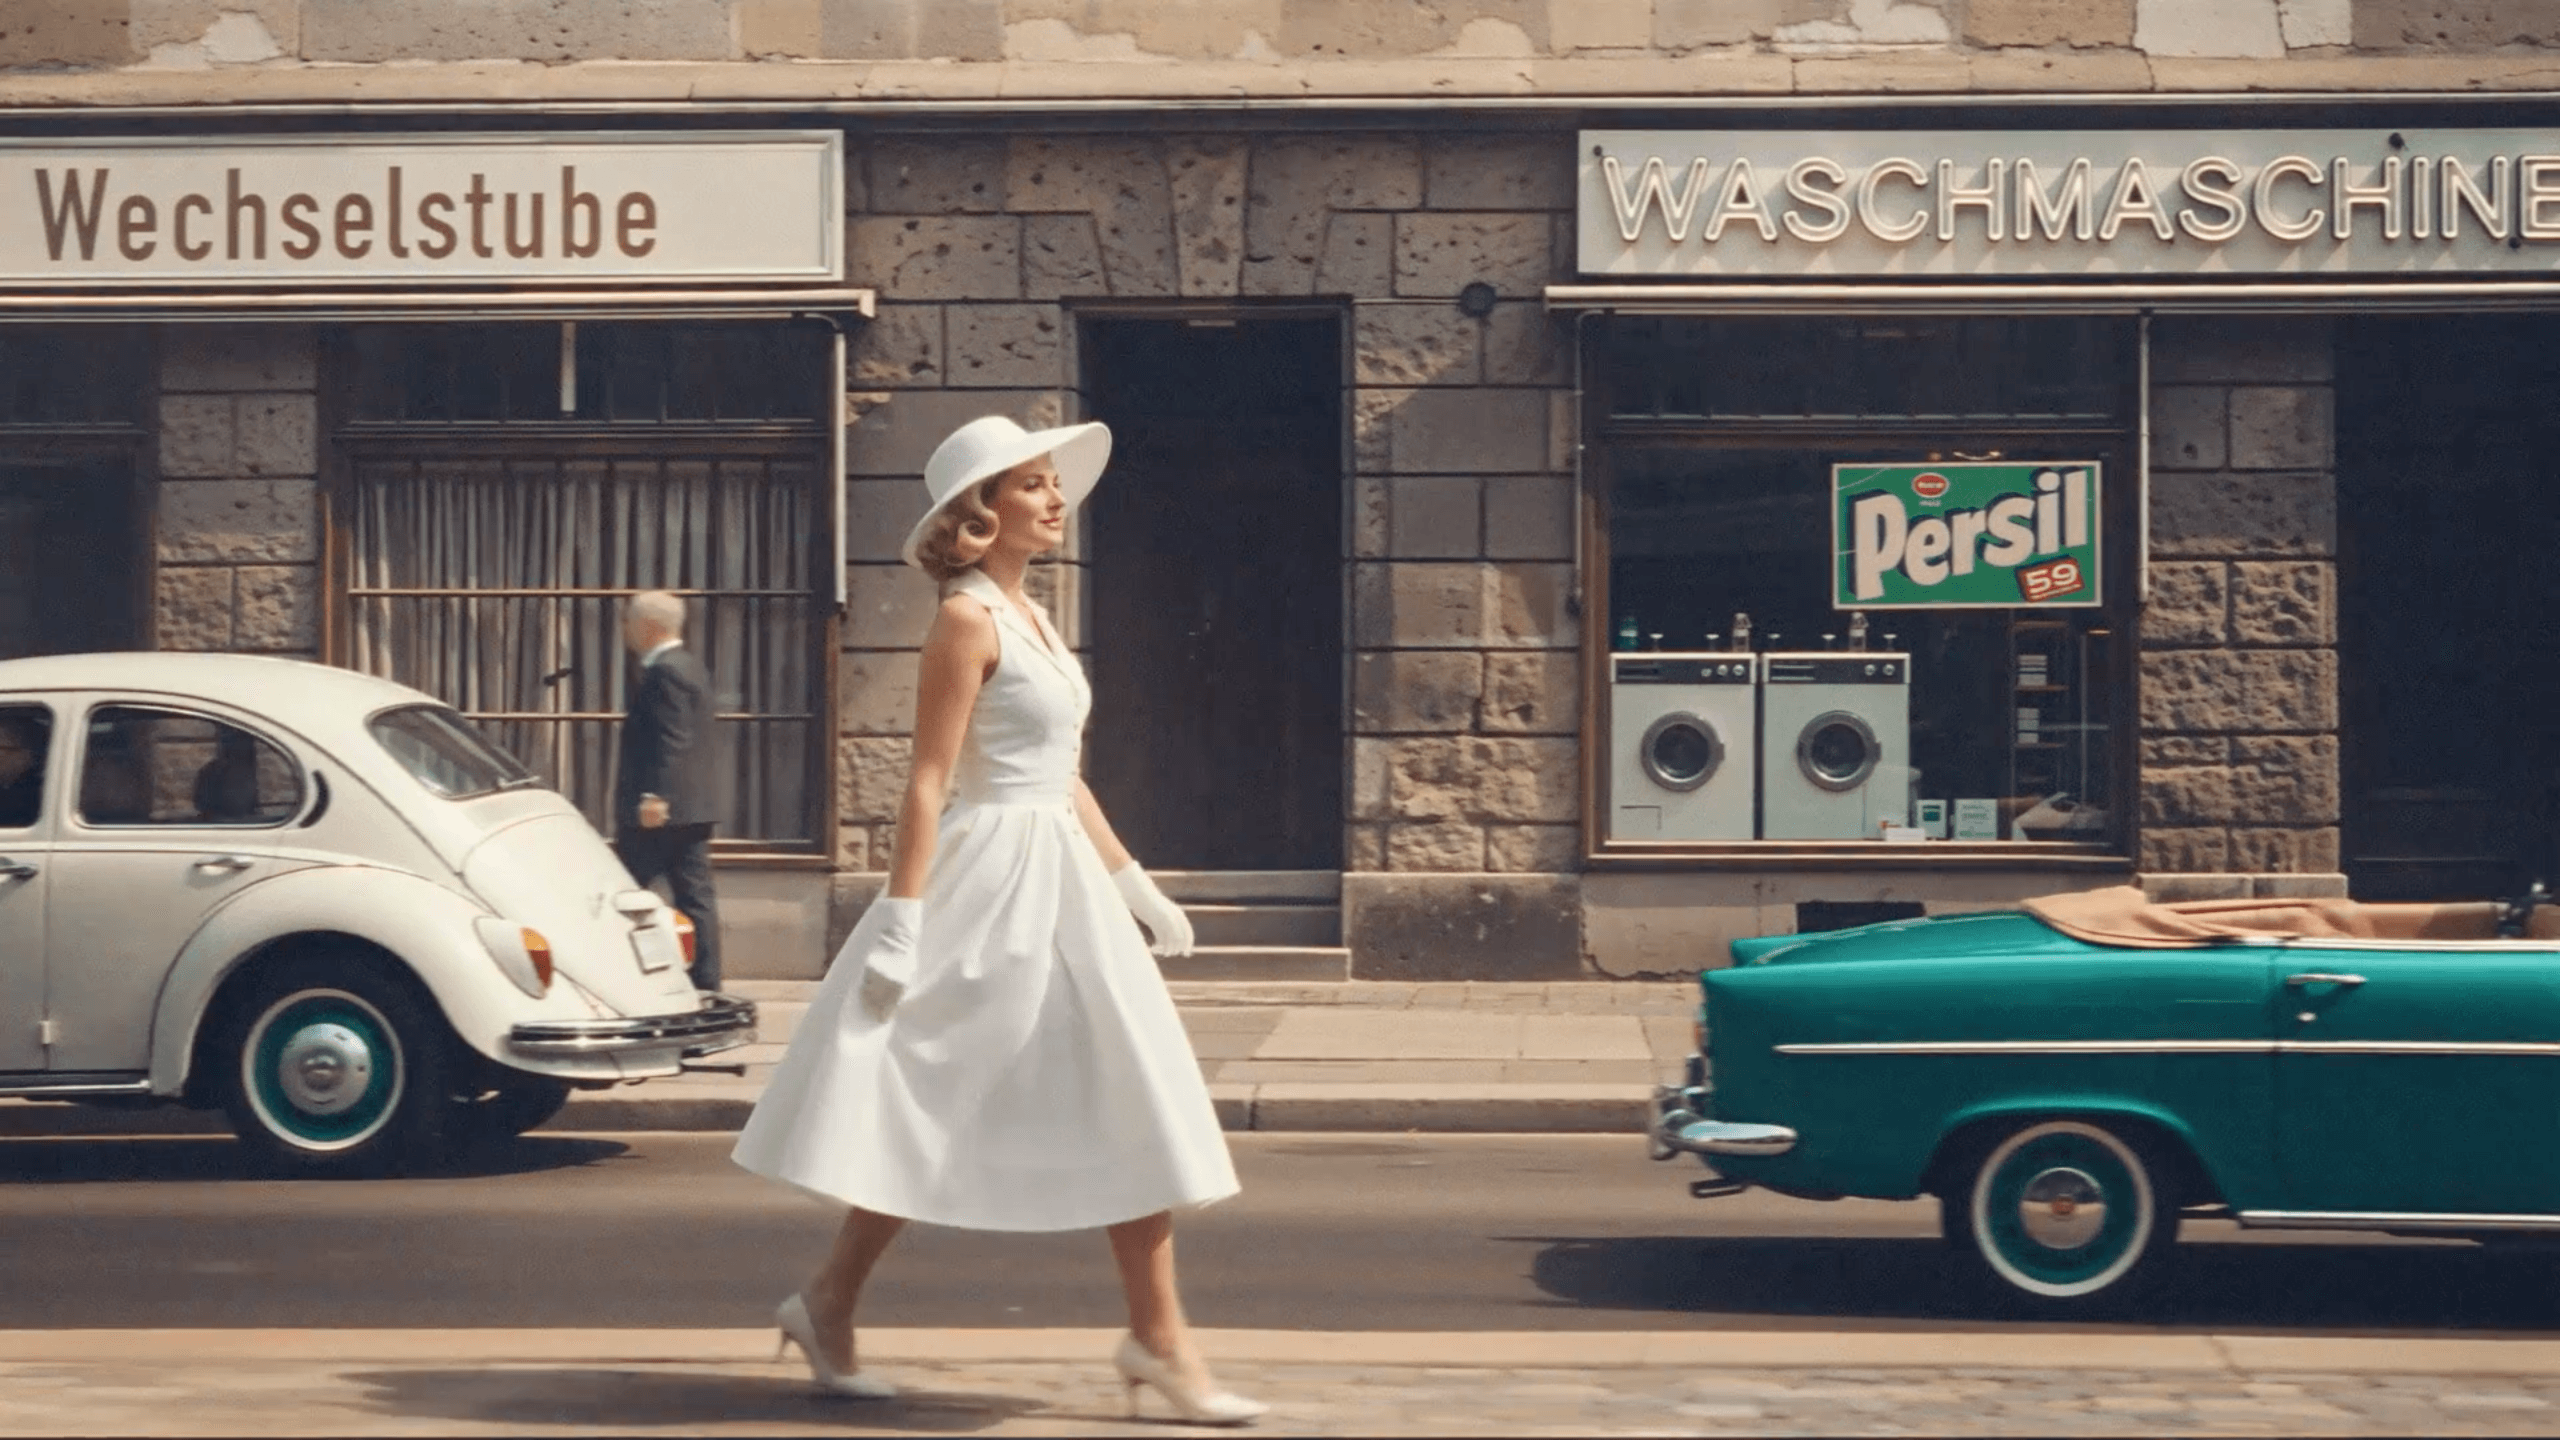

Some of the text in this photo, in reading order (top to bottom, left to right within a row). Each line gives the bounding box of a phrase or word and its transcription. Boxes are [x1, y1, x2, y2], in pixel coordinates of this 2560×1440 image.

[34, 166, 658, 261] Wechselstube
[1602, 154, 2560, 242] WASCHMASCHINE
[1854, 469, 2088, 601] Persil
[2026, 563, 2078, 595] 59
